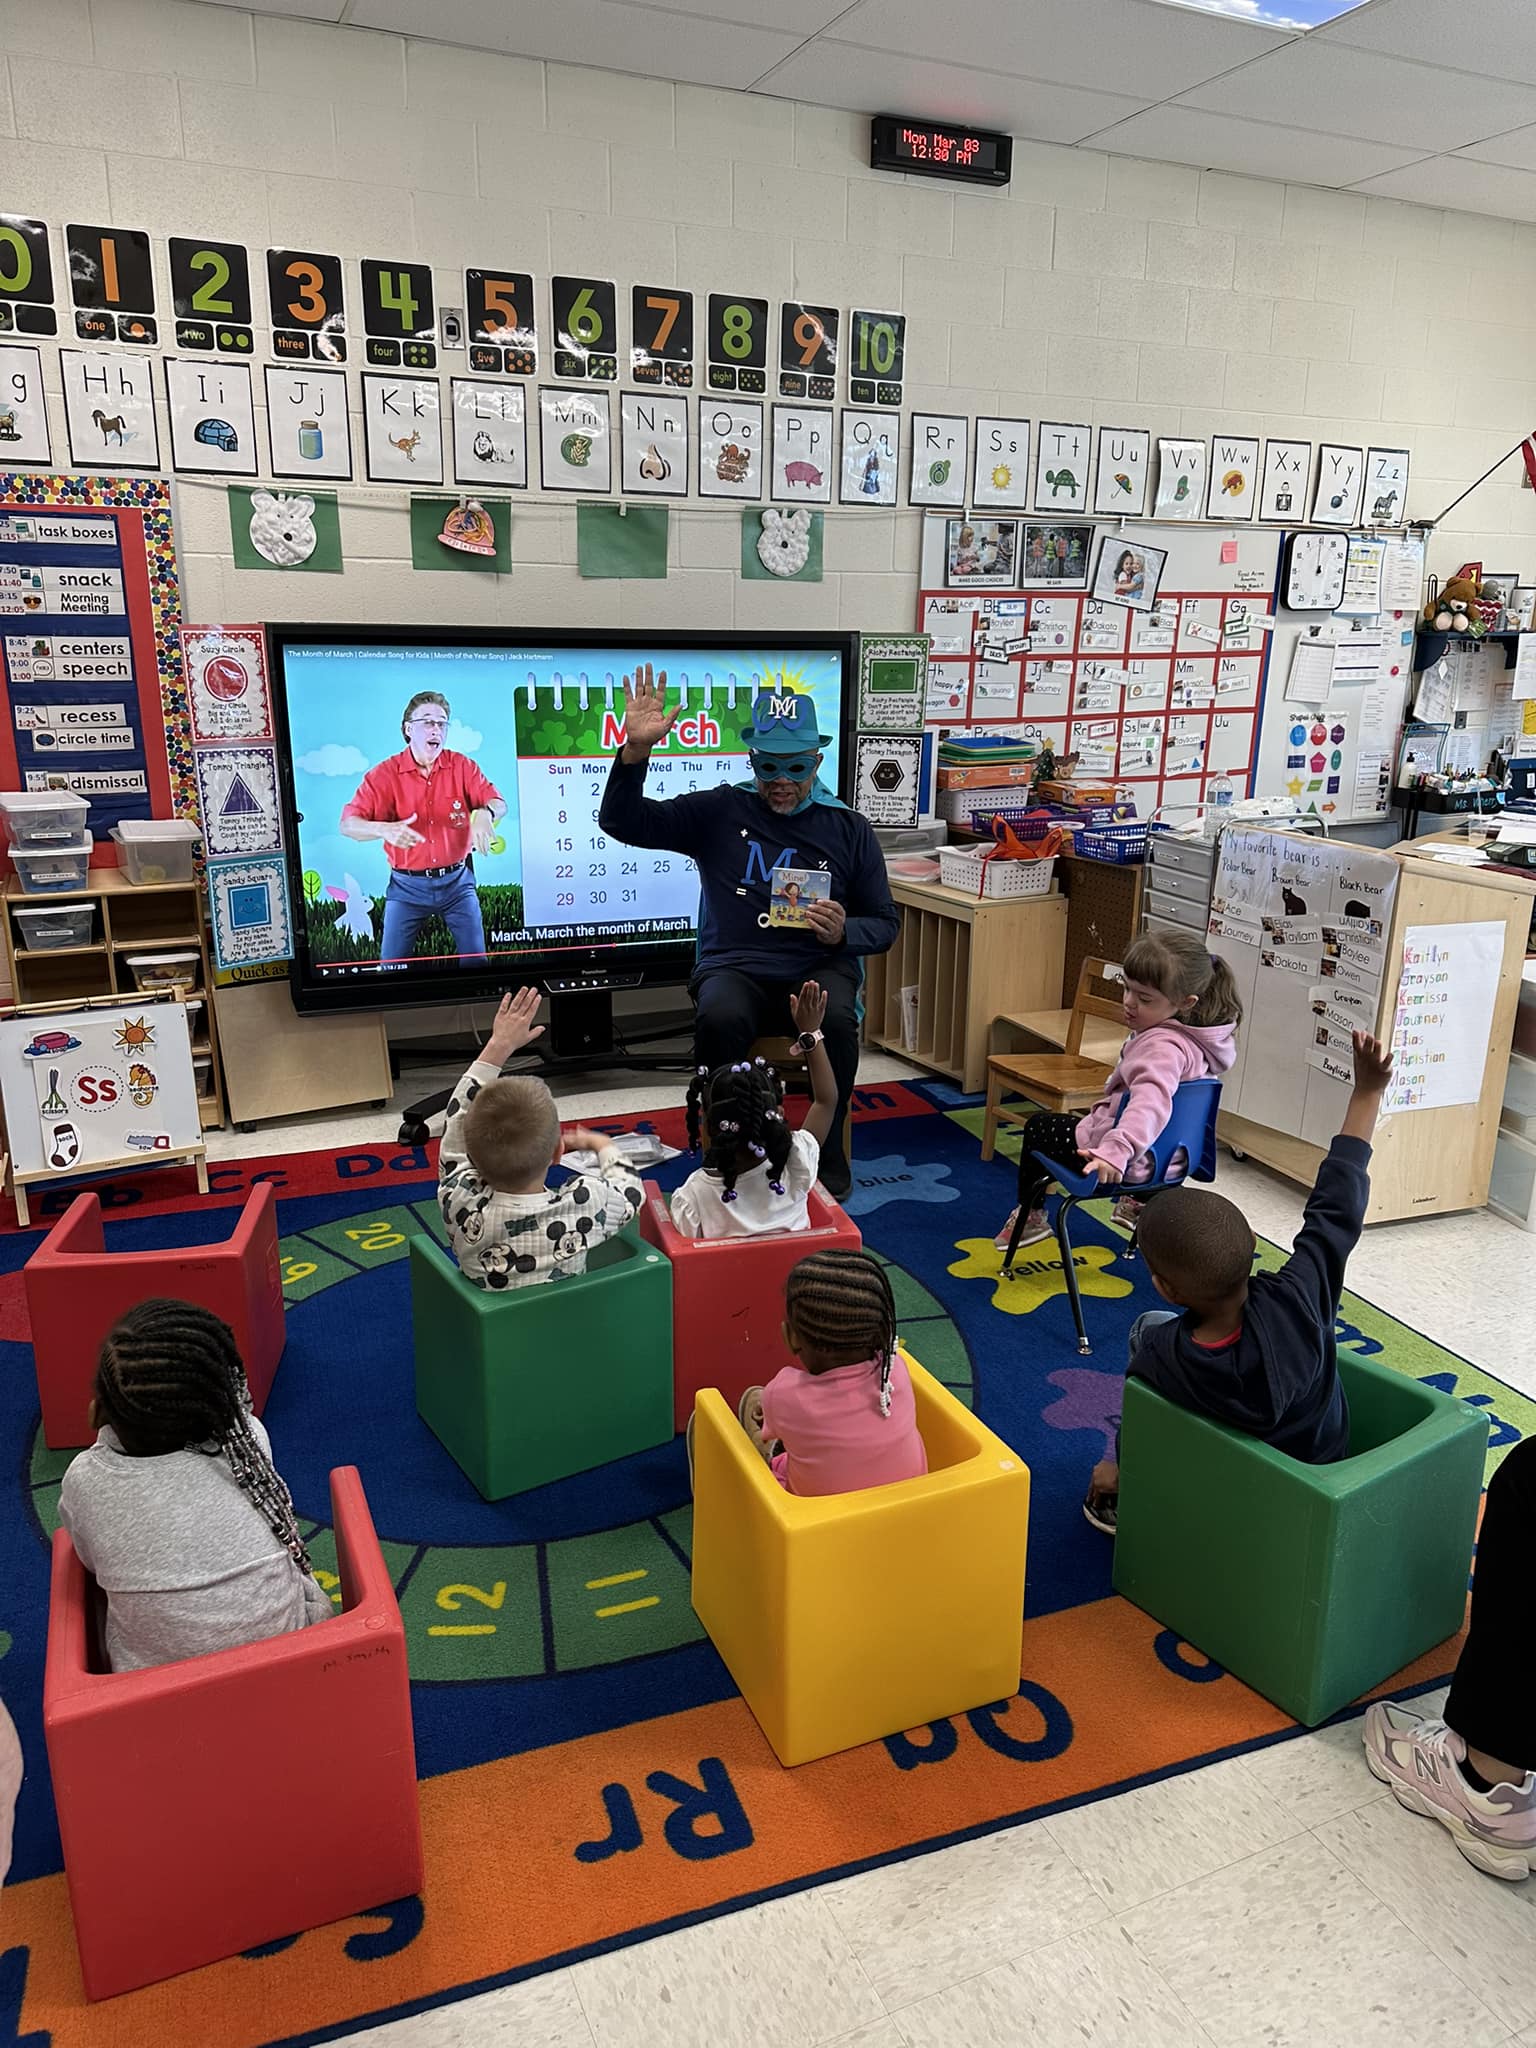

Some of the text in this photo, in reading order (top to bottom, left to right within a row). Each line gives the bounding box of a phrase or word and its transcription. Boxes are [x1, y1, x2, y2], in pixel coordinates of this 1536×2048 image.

[903, 129, 980, 152] Mon Mar 03
[911, 145, 972, 165] 12:30 PM
[101, 238, 120, 302] 1
[190, 250, 233, 313] 2
[285, 261, 326, 322] 3
[379, 271, 419, 330] 4
[483, 280, 518, 333] 5
[567, 288, 603, 345] 6
[646, 296, 680, 353] 7
[85, 319, 106, 331] one
[722, 304, 753, 359] 8
[184, 328, 206, 342] two
[278, 336, 305, 350] three
[793, 313, 826, 365] 9
[373, 344, 393, 357] four
[858, 320, 895, 374] 10
[711, 369, 733, 384] eight
[857, 386, 870, 397] ten
[38, 525, 114, 539] task boxes
[59, 573, 113, 587] snack
[61, 593, 109, 605] Morning
[61, 603, 110, 614] Meeting
[60, 641, 125, 655] centers
[200, 645, 245, 655] Suzy Circle
[302, 650, 323, 658] Month
[325, 650, 333, 658] of
[388, 651, 404, 660] Song
[63, 662, 128, 678] speech
[60, 711, 117, 723] recess
[602, 712, 719, 748] Mrch
[58, 732, 131, 745] circle time
[207, 762, 266, 772] Tommy Triangle
[548, 760, 731, 774] Sun Mon Wed Thu Fri
[71, 774, 144, 790] dismissal
[558, 782, 665, 797] 1 2 4
[558, 810, 567, 823] 8
[555, 837, 606, 851] 15 16
[1225, 829, 1238, 848] My
[1243, 835, 1278, 856] favorite
[1284, 841, 1310, 864] bear
[555, 861, 670, 878] 22 23 24 25
[1222, 857, 1256, 876] Polar Bear
[223, 874, 273, 886] Sandy Square
[1272, 868, 1293, 886] Brown
[1340, 876, 1384, 895] Black Bear
[556, 890, 637, 906] 29 30 31
[1225, 903, 1242, 916] Ace
[491, 918, 688, 943] March, March the month of March
[1223, 925, 1254, 943] Journey
[1337, 932, 1376, 947] Christian
[1341, 943, 1370, 965] Baylee
[1404, 944, 1449, 967] Kaitlyn
[1275, 956, 1308, 973] Dakota
[231, 965, 285, 981] Quick as
[1337, 966, 1361, 983] Owen
[1326, 1008, 1354, 1029] Mason
[129, 1083, 160, 1092] seahorse
[41, 1107, 69, 1115] scissors
[58, 1133, 74, 1144] sock
[856, 1171, 914, 1188] blue
[345, 1222, 408, 1253] 20
[428, 1580, 507, 1636] 12
